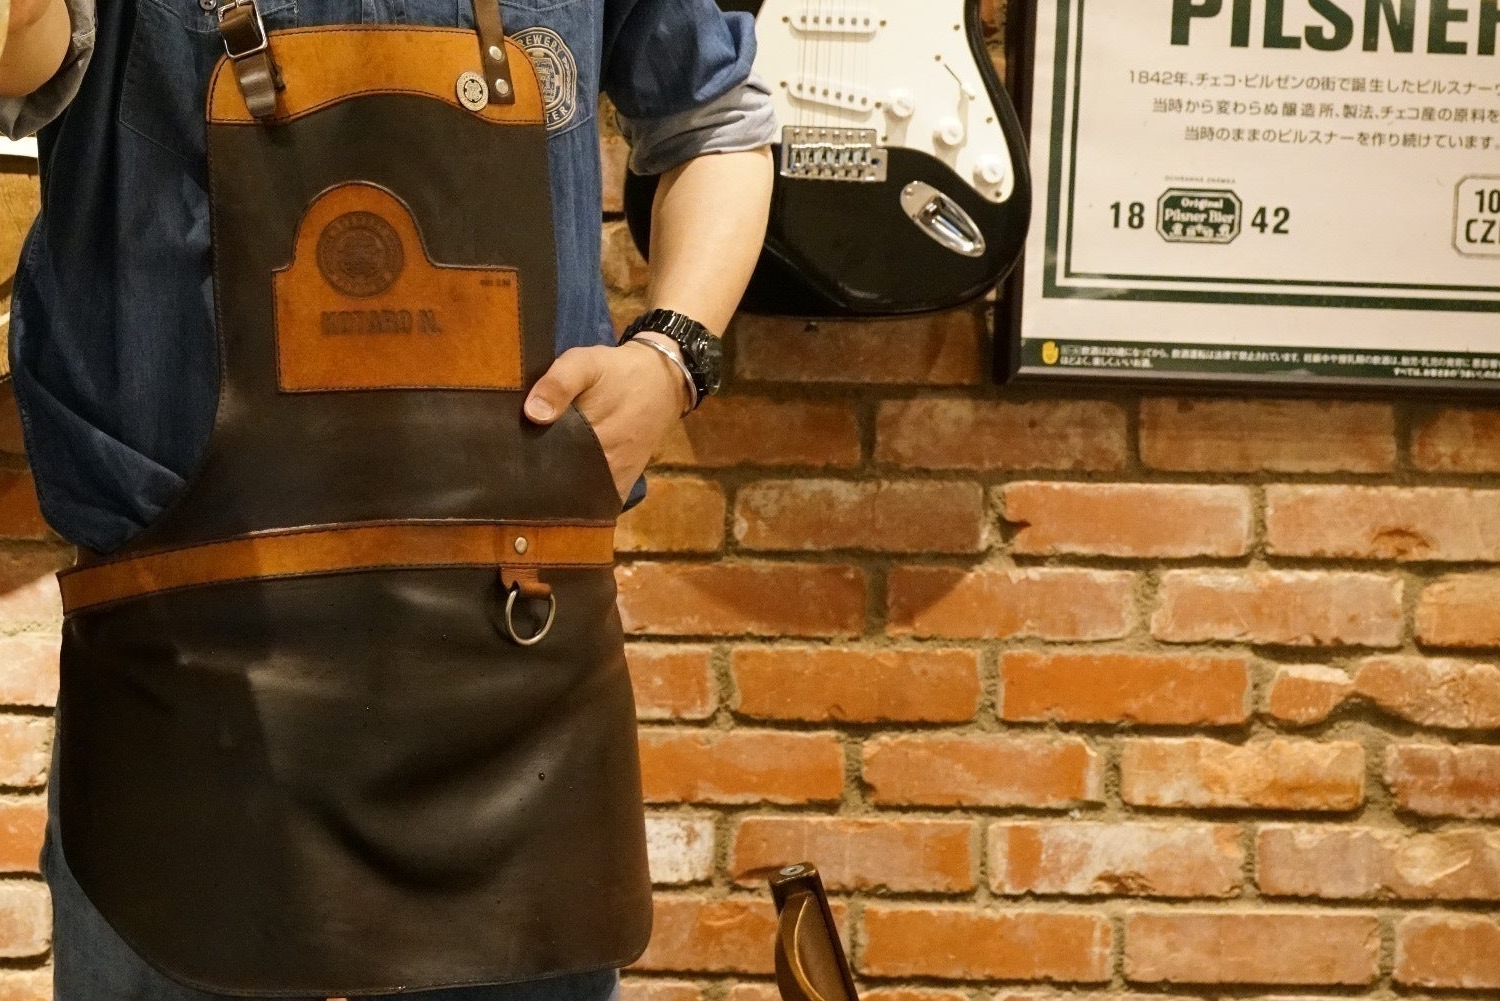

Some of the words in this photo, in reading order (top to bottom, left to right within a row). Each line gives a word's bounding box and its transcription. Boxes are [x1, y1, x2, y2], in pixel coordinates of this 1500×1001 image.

[1180, 197, 1224, 212] Original
[1110, 201, 1145, 230] 18
[1251, 206, 1290, 235] 42
[1164, 208, 1208, 223] Pilsner
[1209, 210, 1236, 224] Bier
[1465, 218, 1500, 244] CZ
